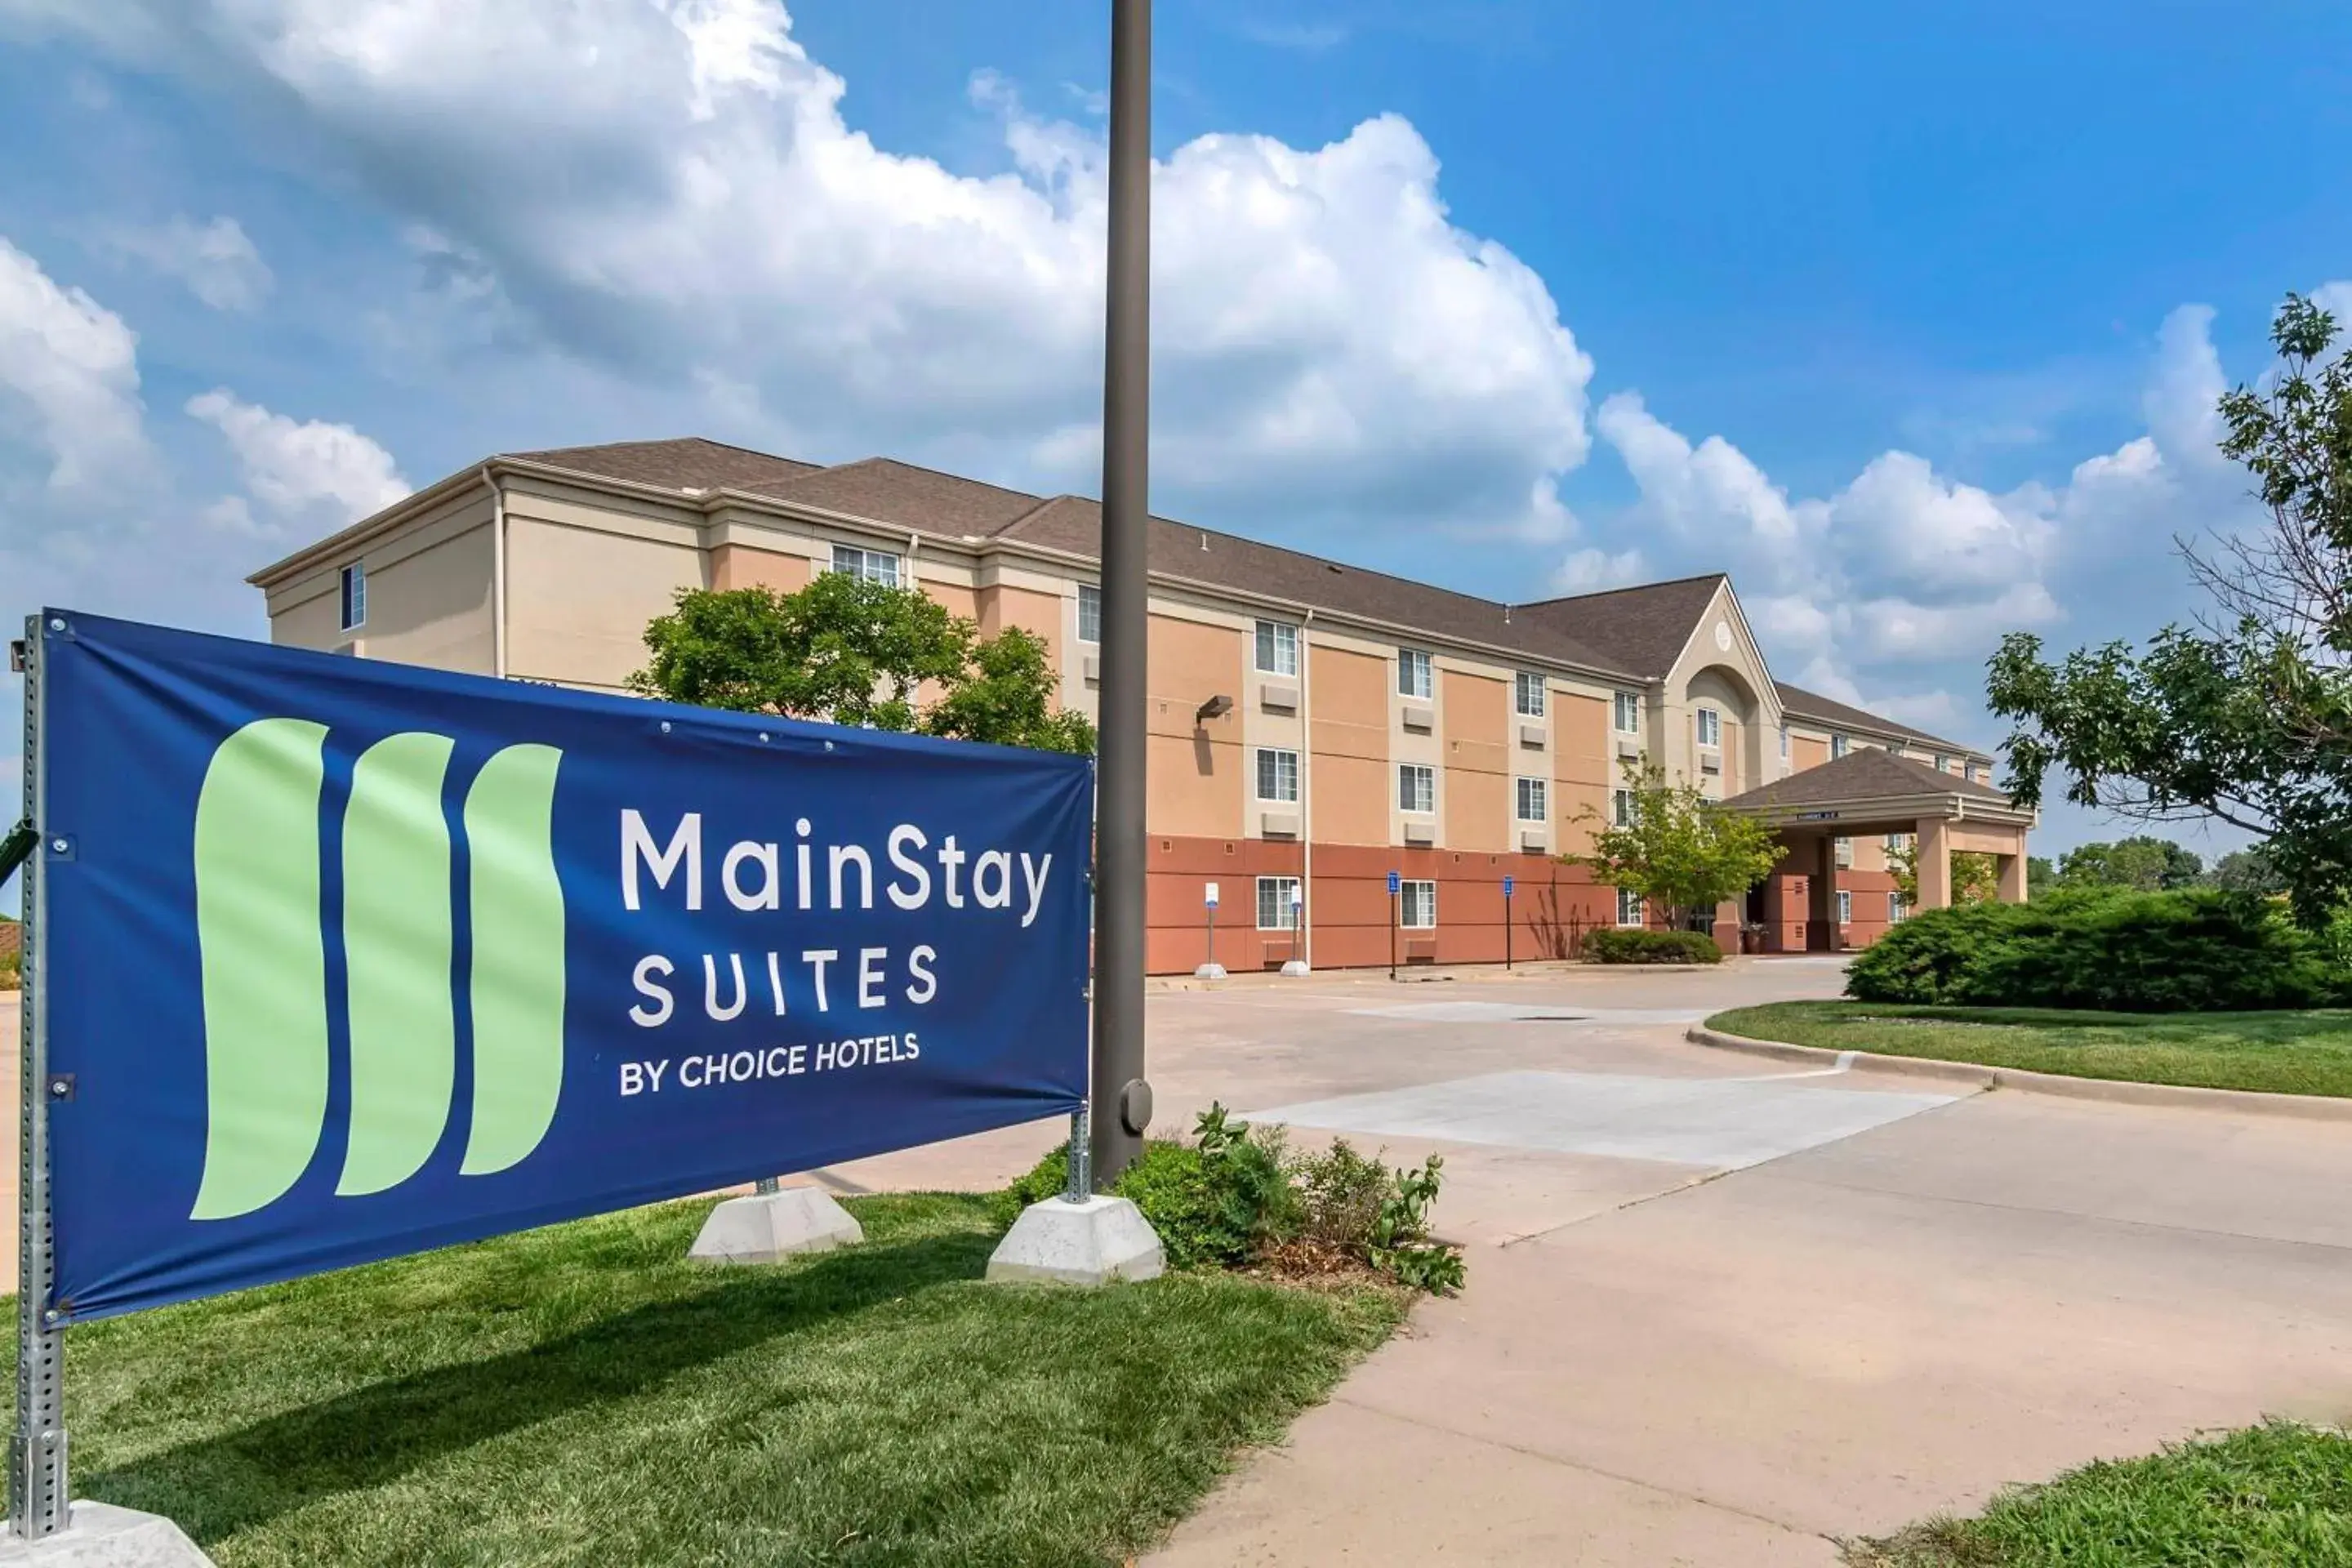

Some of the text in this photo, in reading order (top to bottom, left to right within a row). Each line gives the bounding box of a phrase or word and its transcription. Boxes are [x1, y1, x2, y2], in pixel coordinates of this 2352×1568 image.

[621, 808, 1052, 928] MainStay
[628, 945, 937, 1027] SUITES
[620, 1032, 920, 1096] BY CHOICE HOTELS
